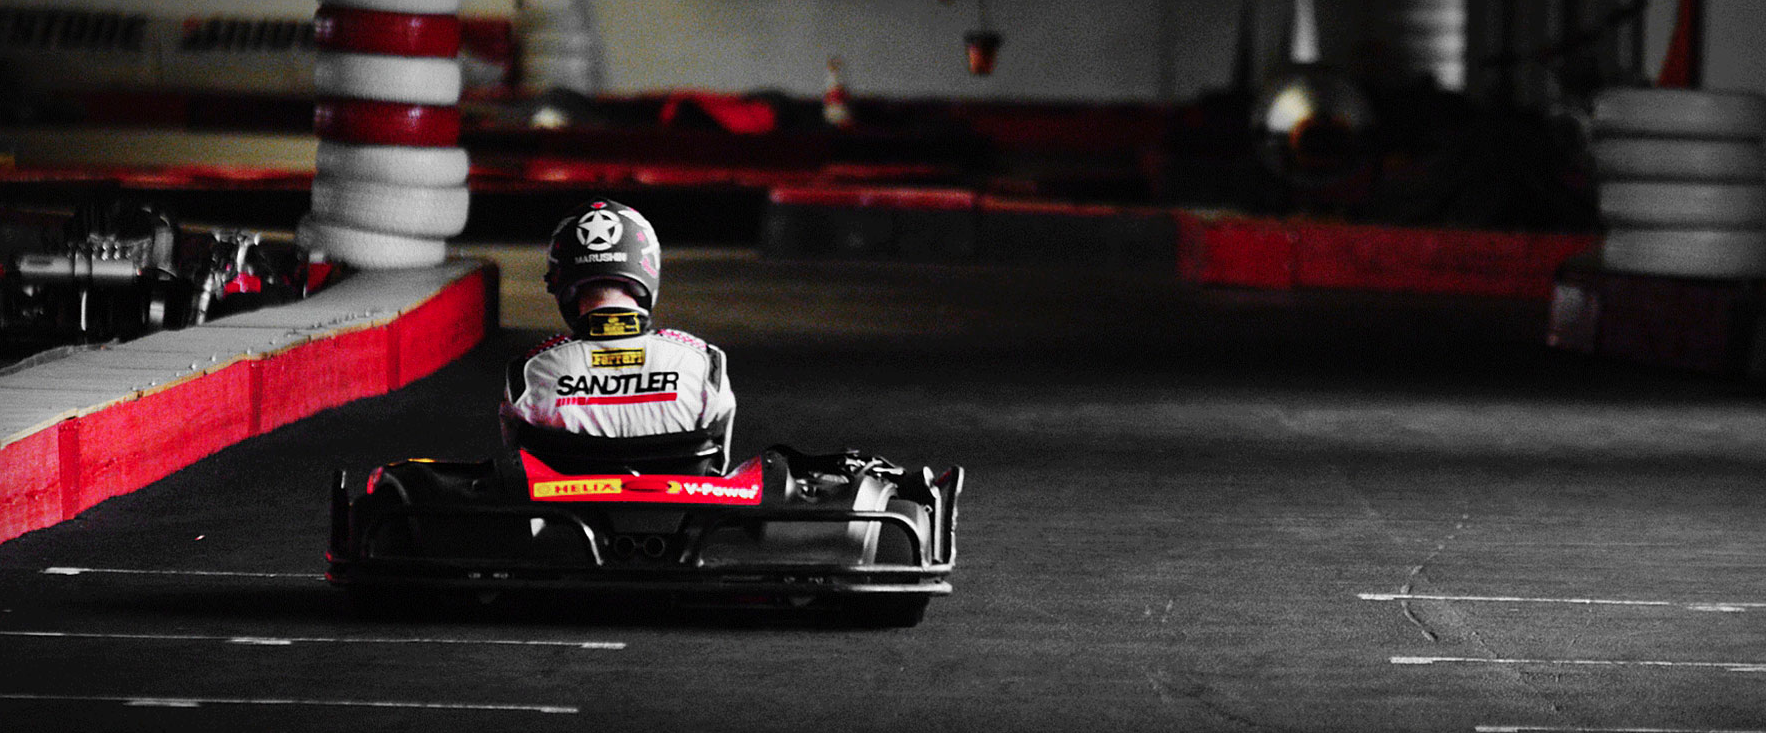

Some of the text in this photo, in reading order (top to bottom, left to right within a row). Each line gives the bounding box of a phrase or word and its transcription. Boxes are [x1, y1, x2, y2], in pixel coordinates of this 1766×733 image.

[575, 252, 627, 263] MARUSHIN
[593, 353, 643, 366] Ferrari
[556, 371, 679, 396] SANDTLER
[554, 483, 617, 494] HELIX
[683, 482, 758, 499] V-Power
